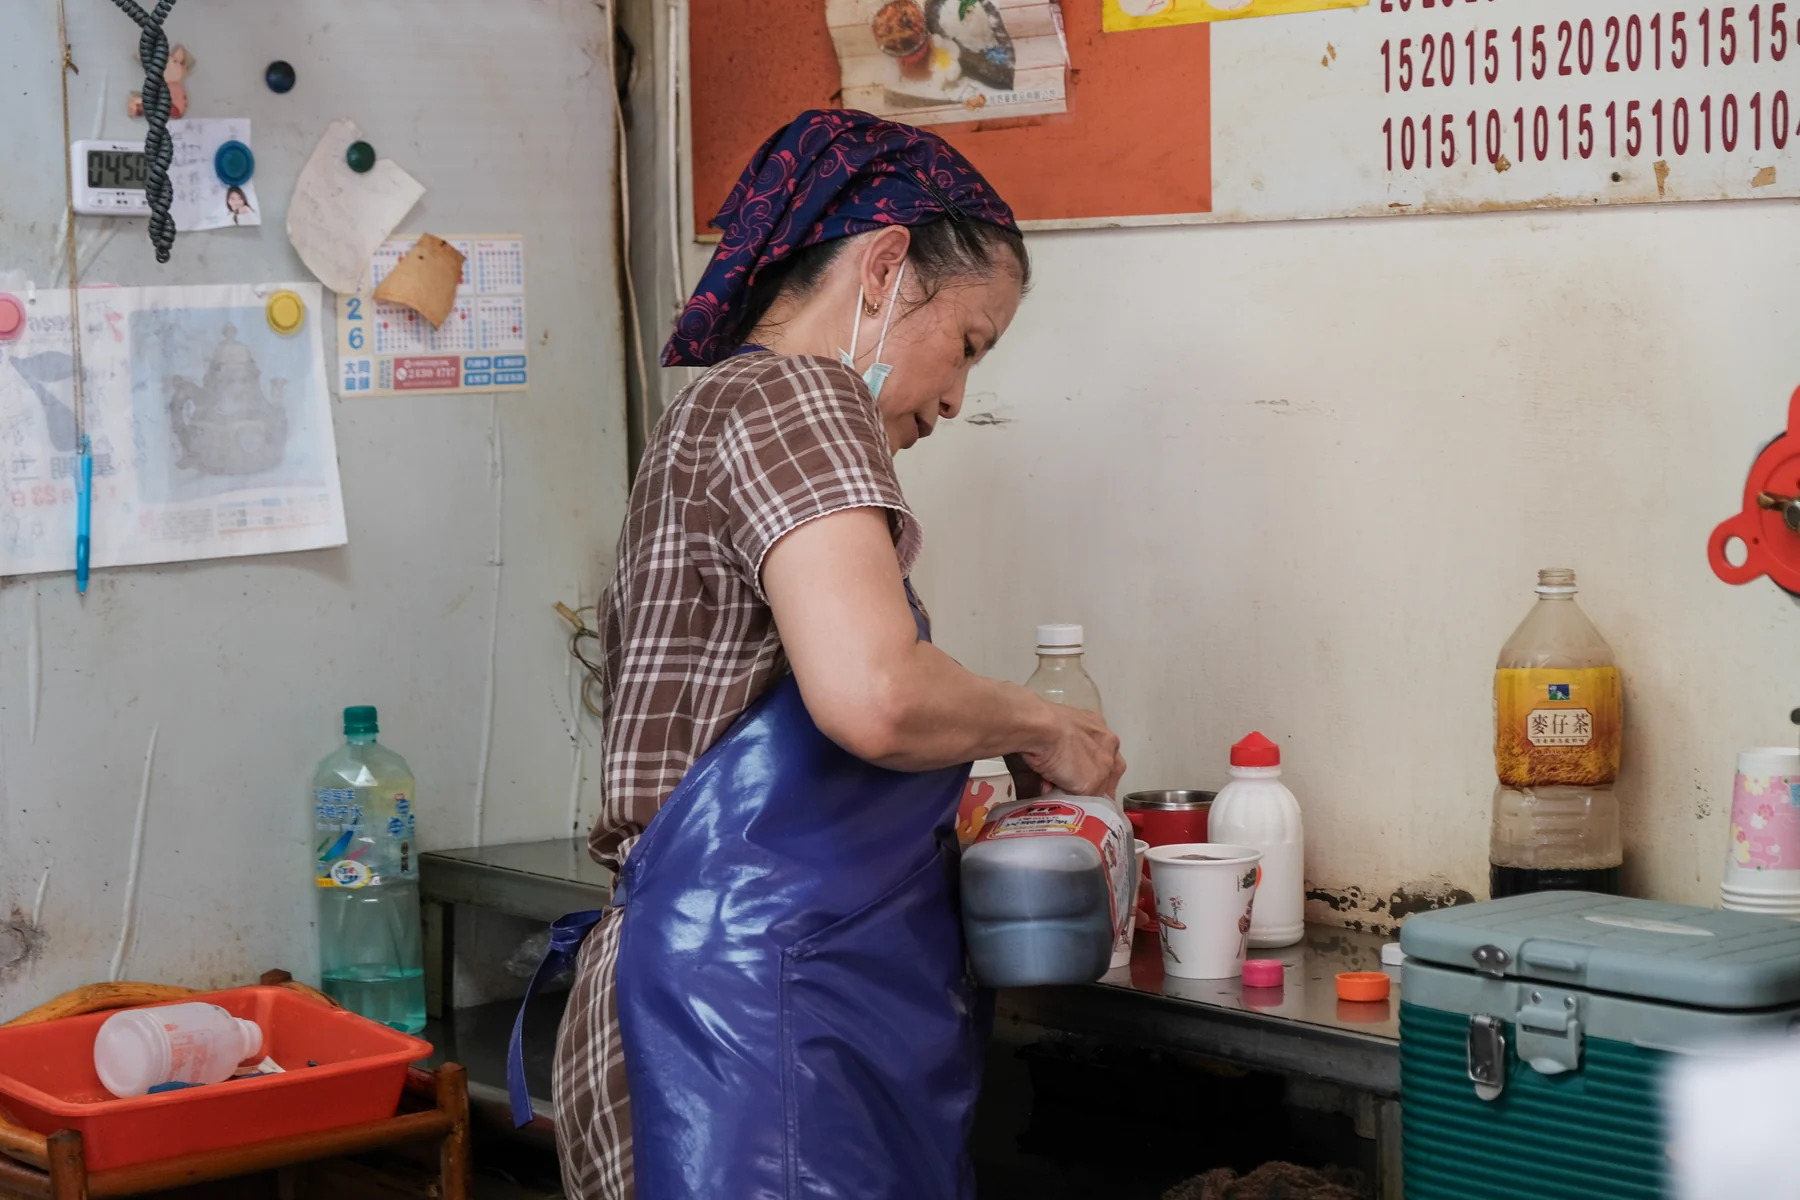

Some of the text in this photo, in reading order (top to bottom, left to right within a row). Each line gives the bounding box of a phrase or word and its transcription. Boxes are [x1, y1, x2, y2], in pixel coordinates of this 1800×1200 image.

[1380, 38, 1413, 93] 15
[1421, 32, 1455, 87] 20
[1465, 29, 1498, 85] 15
[1511, 25, 1546, 81] 15
[1557, 18, 1593, 76] 20
[1605, 14, 1642, 73] 20
[1650, 11, 1687, 70] 15
[1698, 7, 1737, 67] 15
[1748, 3, 1787, 63] 15
[1382, 116, 1415, 171] 10
[1421, 114, 1455, 169] 15
[1466, 108, 1501, 165] 10
[1513, 105, 1549, 162] 10
[1558, 103, 1594, 160] 15
[1605, 100, 1641, 158] 15
[1651, 97, 1689, 157] 10
[1700, 93, 1739, 153] 10
[1749, 89, 1789, 150] 10
[1531, 714, 1589, 735] 麥仔茶
